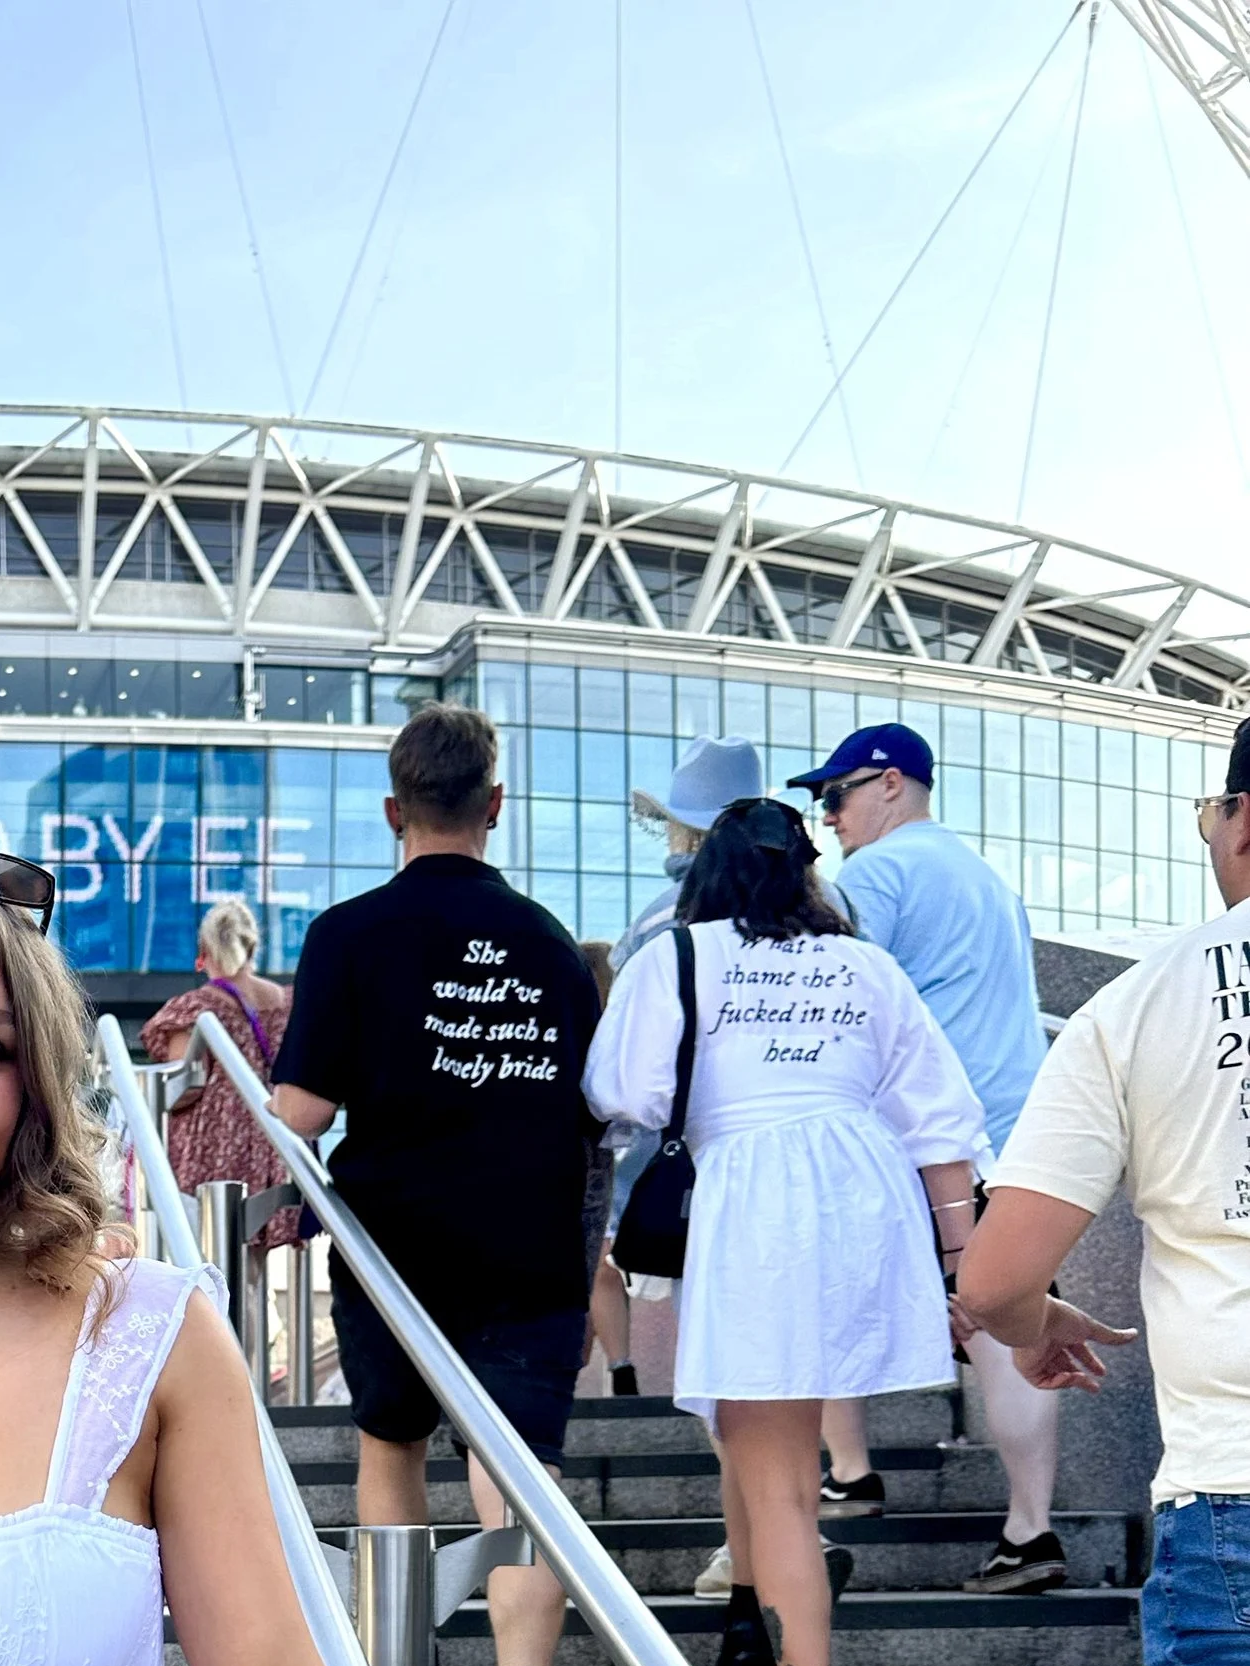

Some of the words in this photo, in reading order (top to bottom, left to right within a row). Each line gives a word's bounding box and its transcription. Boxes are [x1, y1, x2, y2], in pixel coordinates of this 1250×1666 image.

[41, 813, 164, 904] BY
[191, 815, 313, 905] EE
[462, 939, 508, 965] She
[722, 964, 796, 986] shame
[432, 976, 543, 1003] would've
[424, 1014, 483, 1039] made
[485, 1016, 539, 1041] such
[543, 1027, 558, 1043] a
[707, 999, 797, 1035] fucked
[800, 1000, 825, 1023] in
[831, 1001, 867, 1025] the
[763, 1039, 825, 1062] head
[432, 1045, 495, 1088] lovely
[498, 1053, 558, 1081] bride
